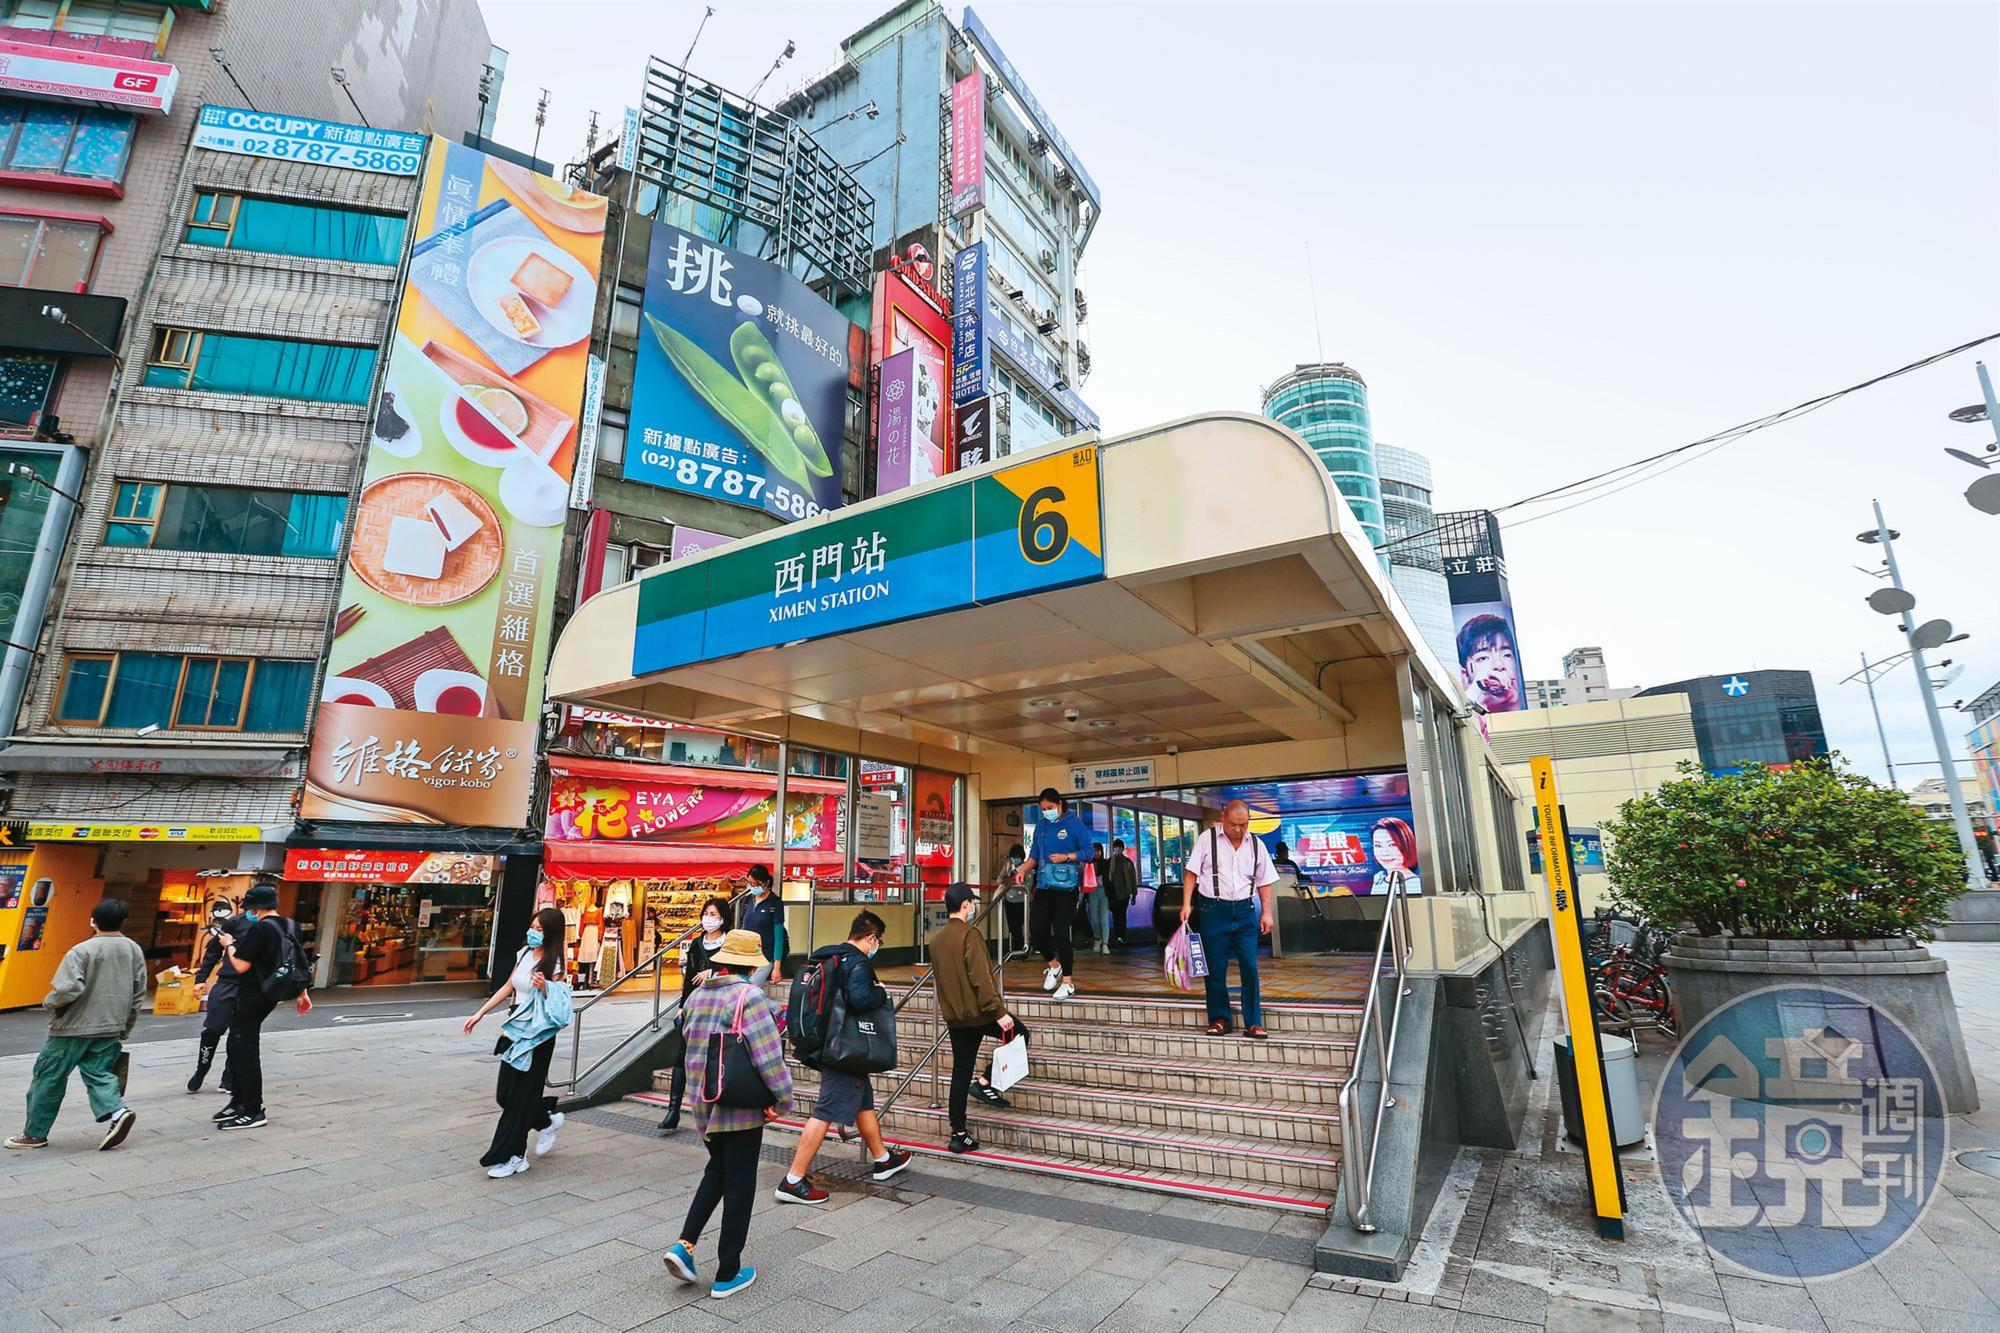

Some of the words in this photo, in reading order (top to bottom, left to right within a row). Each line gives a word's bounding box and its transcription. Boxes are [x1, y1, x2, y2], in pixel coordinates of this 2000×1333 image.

[122, 77, 151, 88] 6F
[227, 111, 322, 138] OCCUPY
[322, 125, 423, 152] 新據點廣告
[243, 138, 269, 155] 02
[272, 138, 418, 173] 8787-5869
[665, 234, 735, 308] 挑
[766, 303, 843, 368] 就挑最好的
[955, 382, 982, 400] HOTEL
[886, 406, 902, 467] 湯の花
[640, 449, 676, 471] (02)
[675, 457, 831, 521] 8787-586
[1017, 486, 1070, 564] 6
[773, 531, 889, 599] 西門站
[495, 547, 542, 678] 首選維格
[768, 600, 817, 624] XIMEN
[820, 579, 890, 614] STATION
[423, 776, 458, 790] vigor
[459, 776, 492, 789] kobo
[636, 791, 675, 806] EYA
[575, 785, 630, 838] 花
[631, 795, 699, 838] FLOWER
[1544, 804, 1555, 834] TOURIST
[1549, 835, 1563, 887] INFORMATION
[858, 1020, 875, 1031] NET
